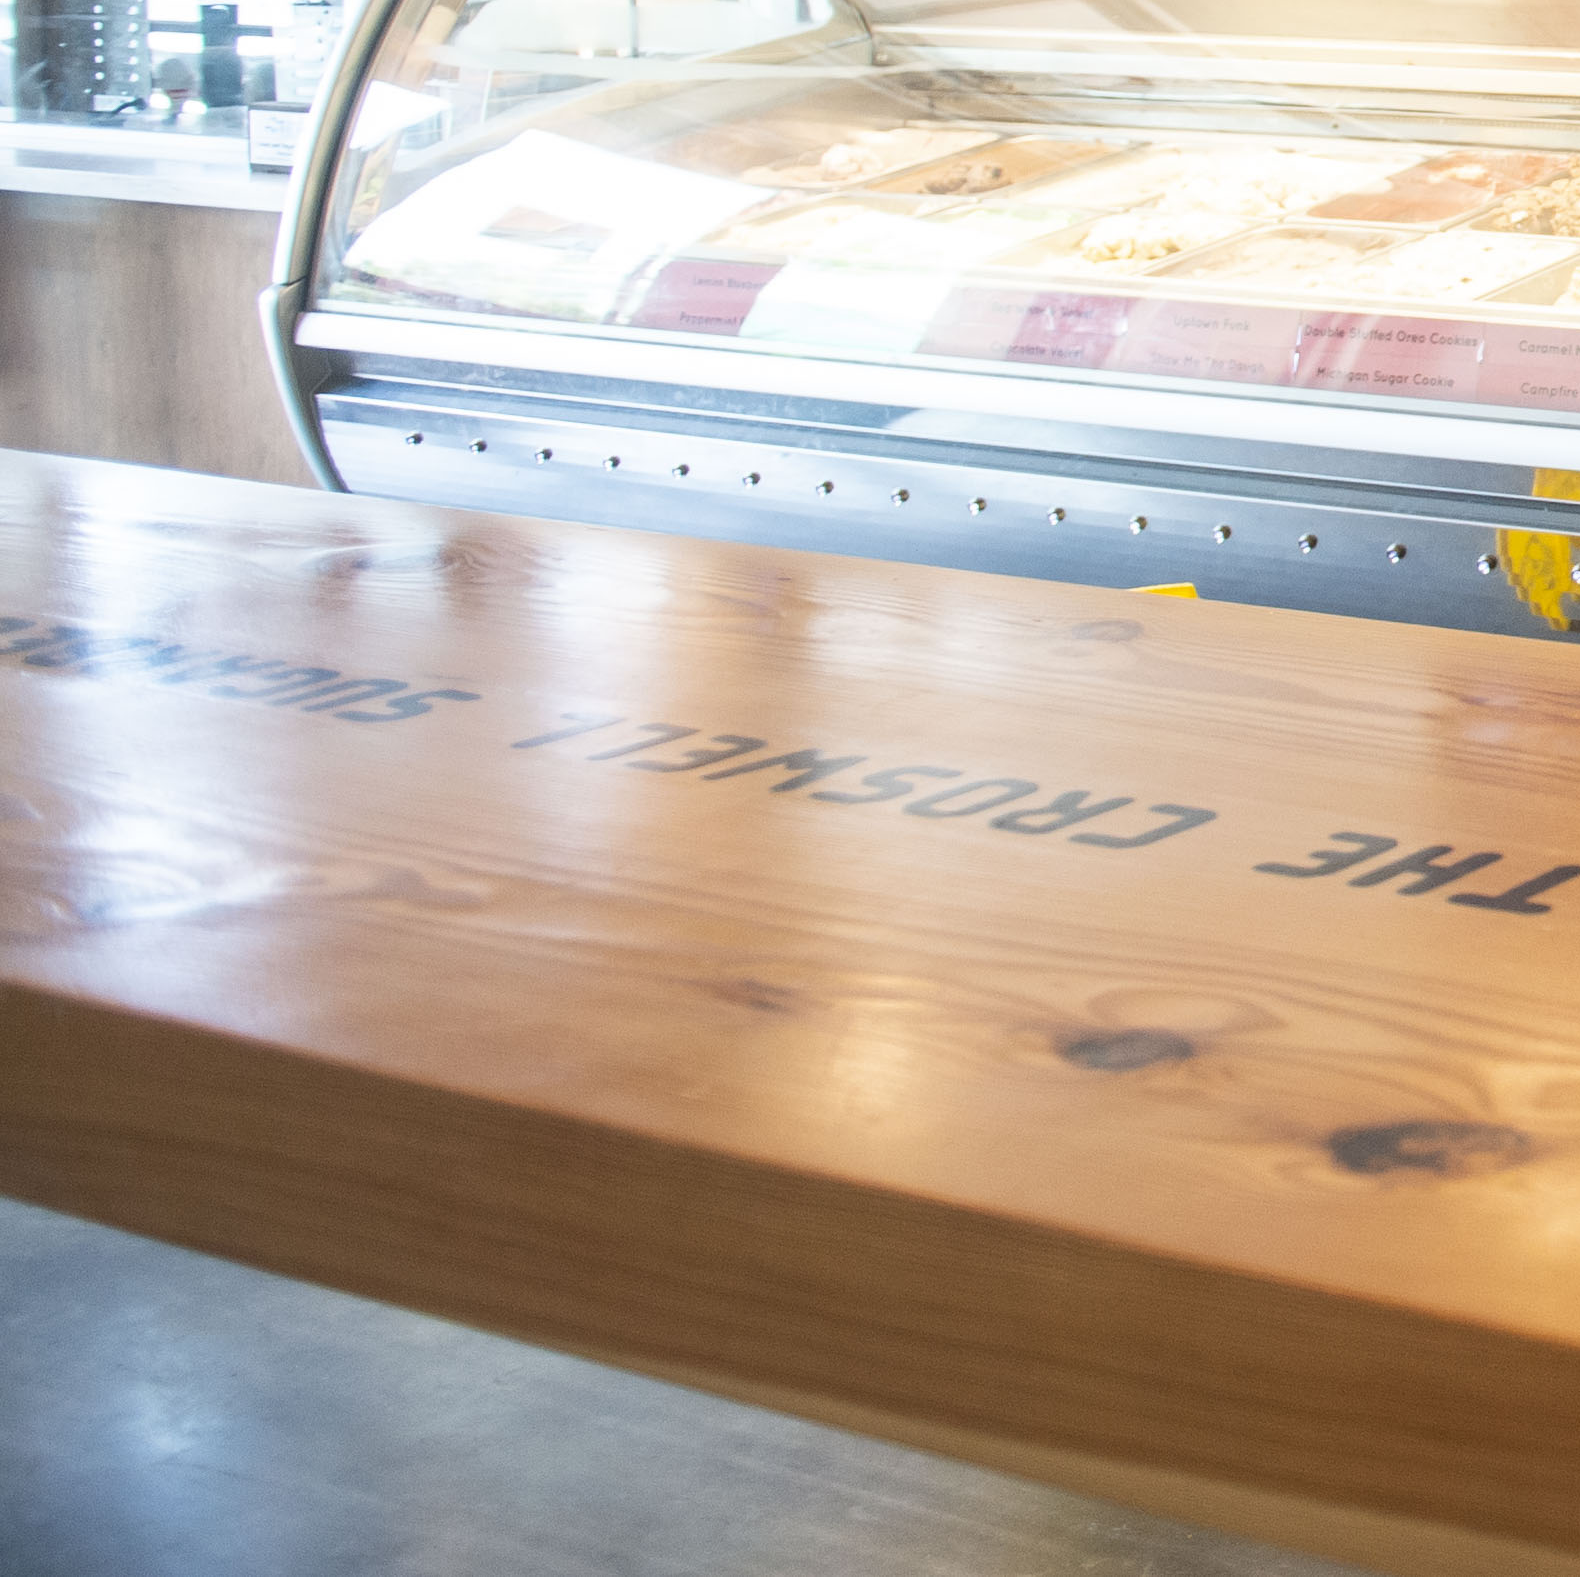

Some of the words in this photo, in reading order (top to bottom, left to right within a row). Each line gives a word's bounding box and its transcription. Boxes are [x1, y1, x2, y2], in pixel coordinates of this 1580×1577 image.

[1304, 324, 1345, 339] Double
[1349, 326, 1393, 342] Stuffed
[1396, 329, 1426, 344] Oreo
[1429, 332, 1478, 348] Cookies
[1519, 340, 1574, 356] Caramel
[1374, 370, 1410, 388] Sugar
[1412, 372, 1456, 389] Cookie
[1520, 382, 1579, 400] Campfire
[509, 711, 1219, 851] CROSWELL
